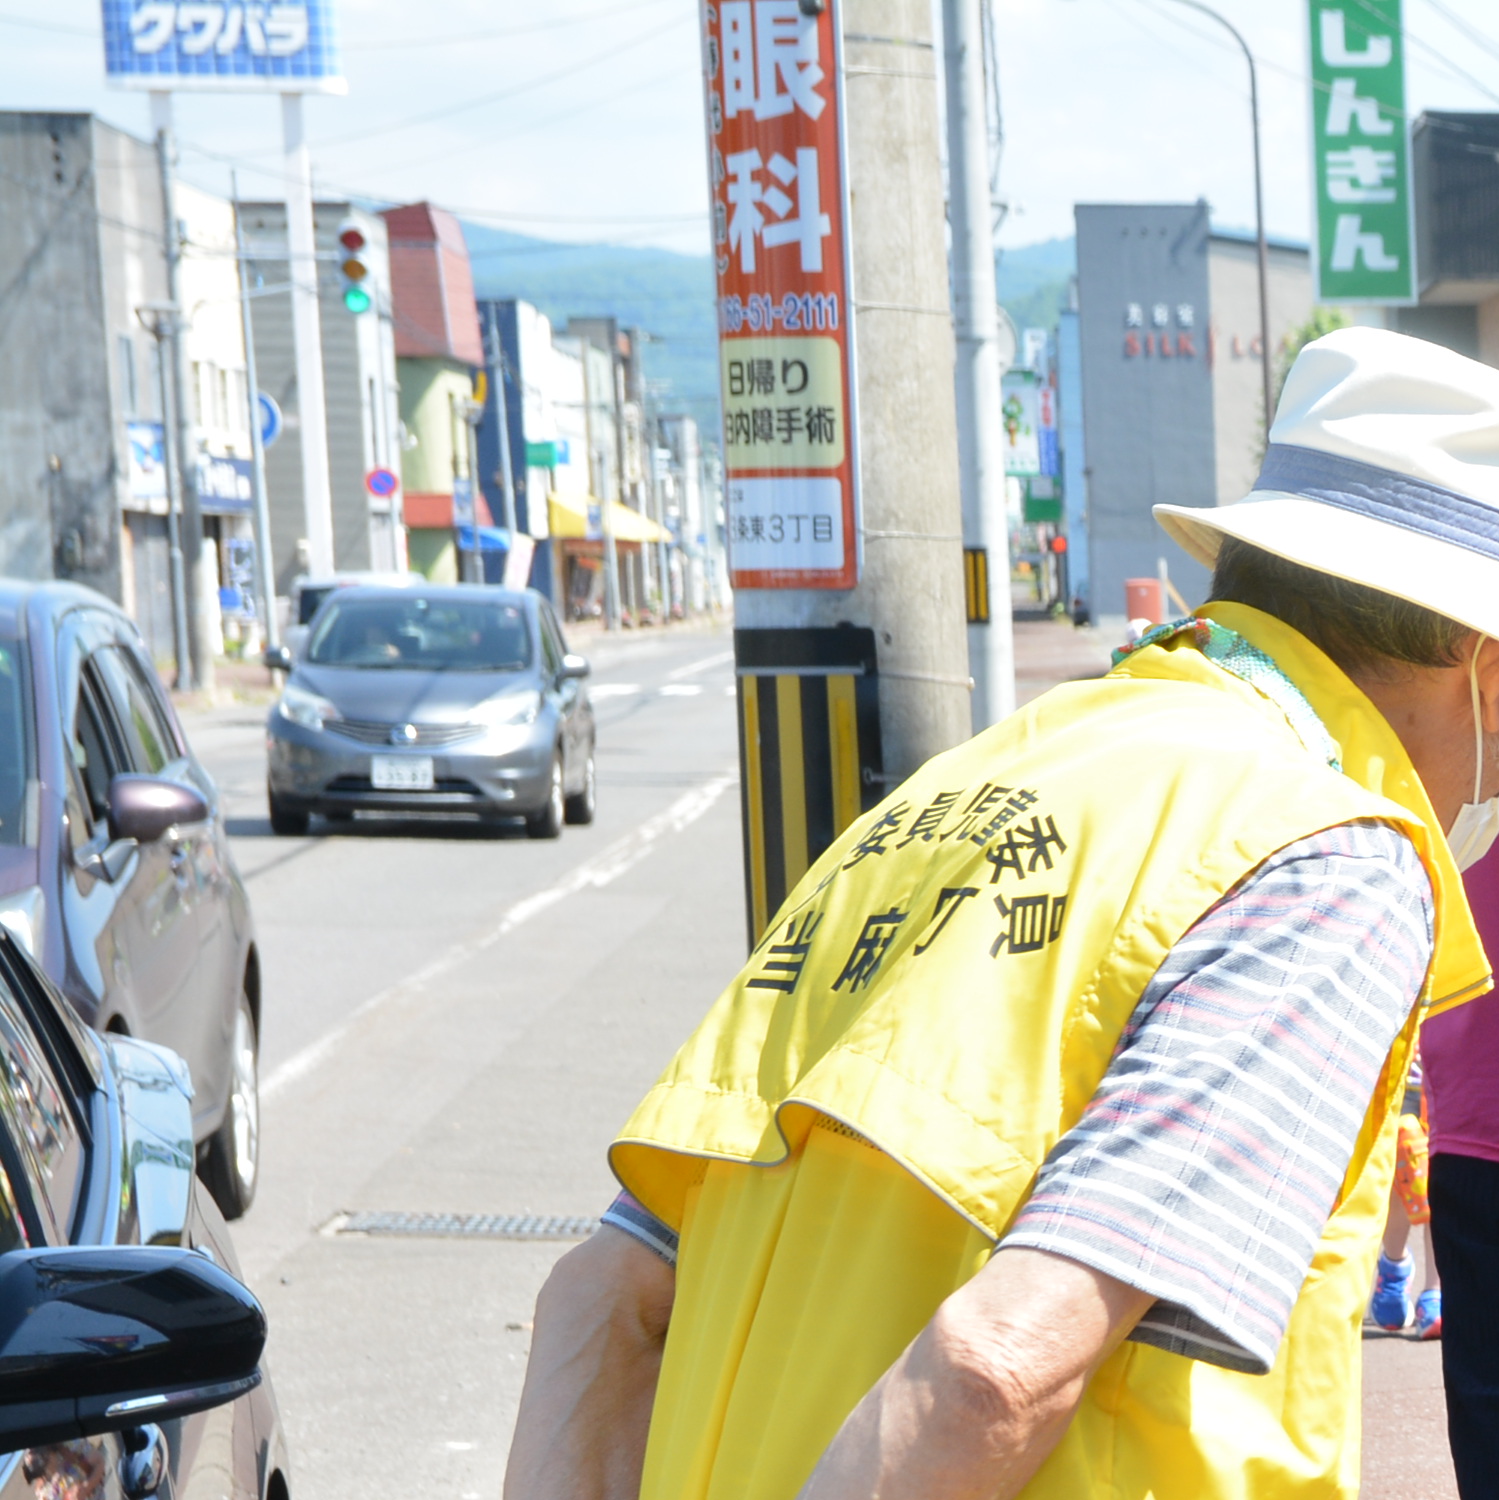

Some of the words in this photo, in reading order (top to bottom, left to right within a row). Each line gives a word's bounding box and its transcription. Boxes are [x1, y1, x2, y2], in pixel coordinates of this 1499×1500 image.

[130, 0, 309, 57] クワバラ
[719, 2, 832, 274] 眼科
[1320, 8, 1398, 273] しんきん
[1125, 332, 1196, 357] SILK
[729, 359, 810, 397] 日帰り
